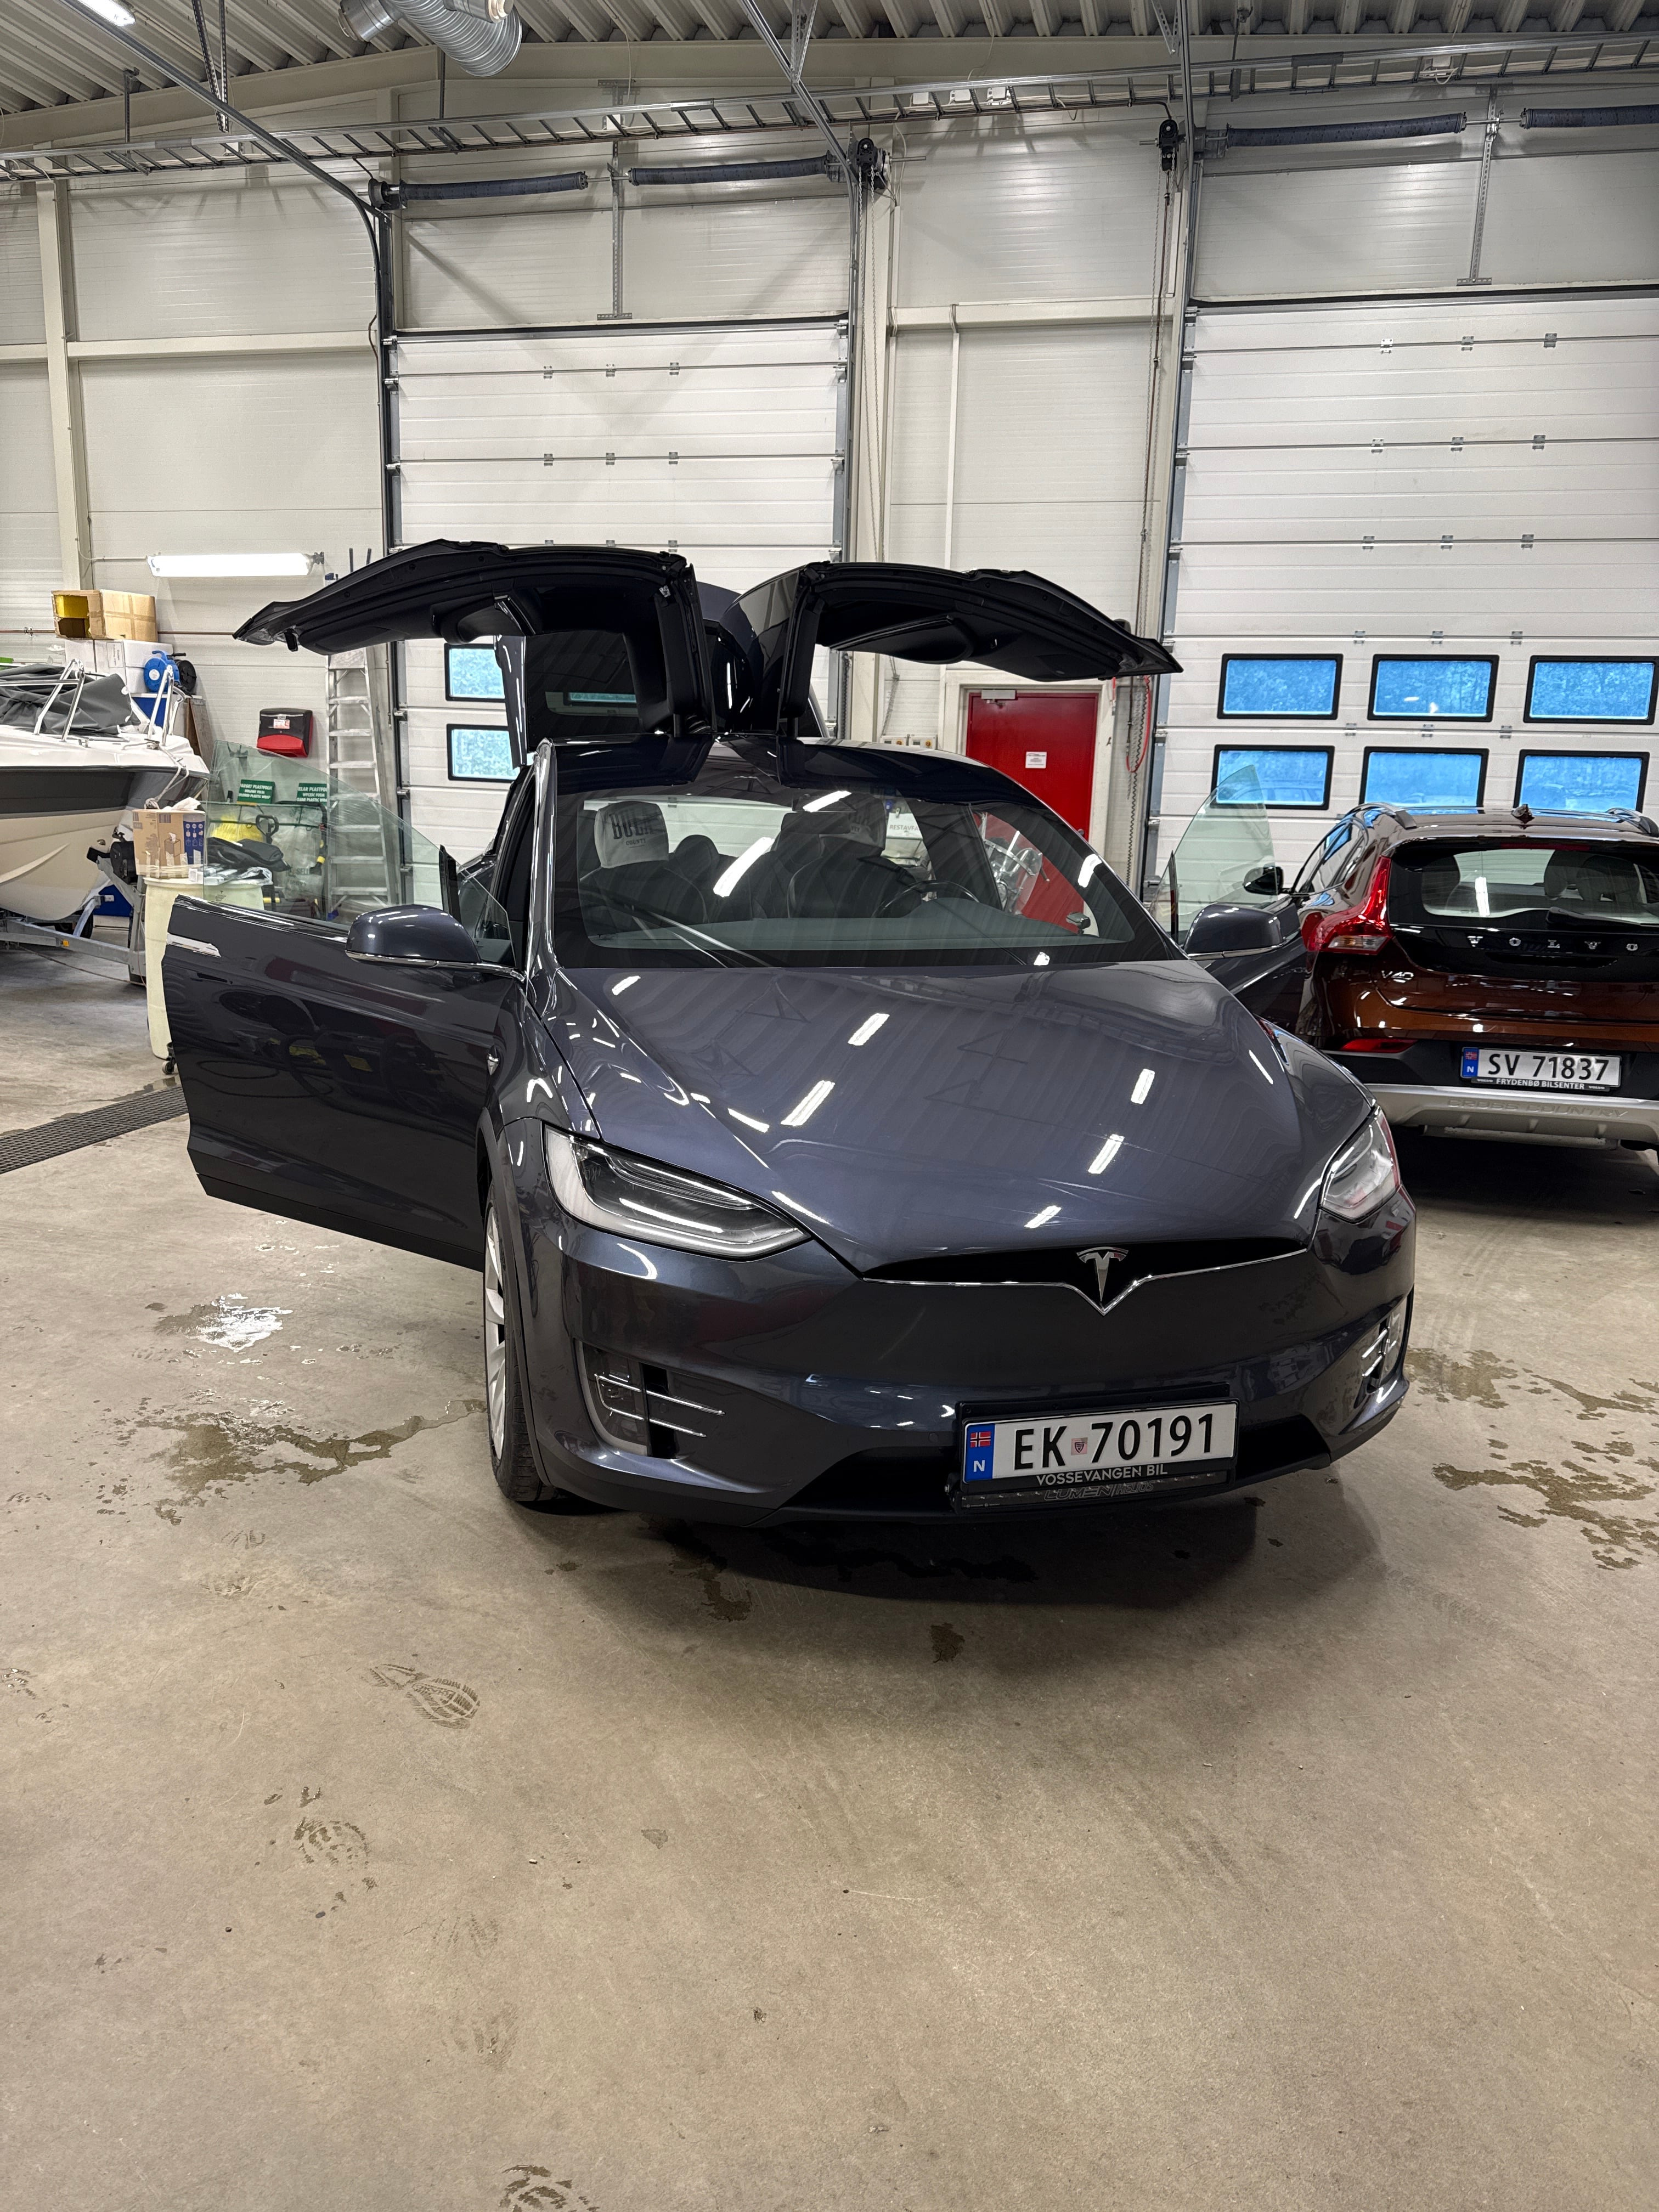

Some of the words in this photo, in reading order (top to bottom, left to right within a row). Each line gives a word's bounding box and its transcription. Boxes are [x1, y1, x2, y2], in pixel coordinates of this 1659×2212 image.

[1467, 935, 1638, 952] VOLVO
[1381, 970, 1414, 981] V40
[1488, 1053, 1520, 1076] SV
[1532, 1056, 1610, 1081] 71837
[1496, 1078, 1540, 1087] FRYDENBØ
[1542, 1081, 1585, 1090] BILSENTER
[1447, 1098, 1519, 1111] CROSS
[1526, 1104, 1629, 1118] COUNTRY
[1014, 1426, 1067, 1470] EK
[1091, 1413, 1213, 1464] 70191
[973, 1459, 985, 1472] N
[1036, 1466, 1142, 1486] VOSSEVANGEN
[1146, 1464, 1168, 1476] BIL
